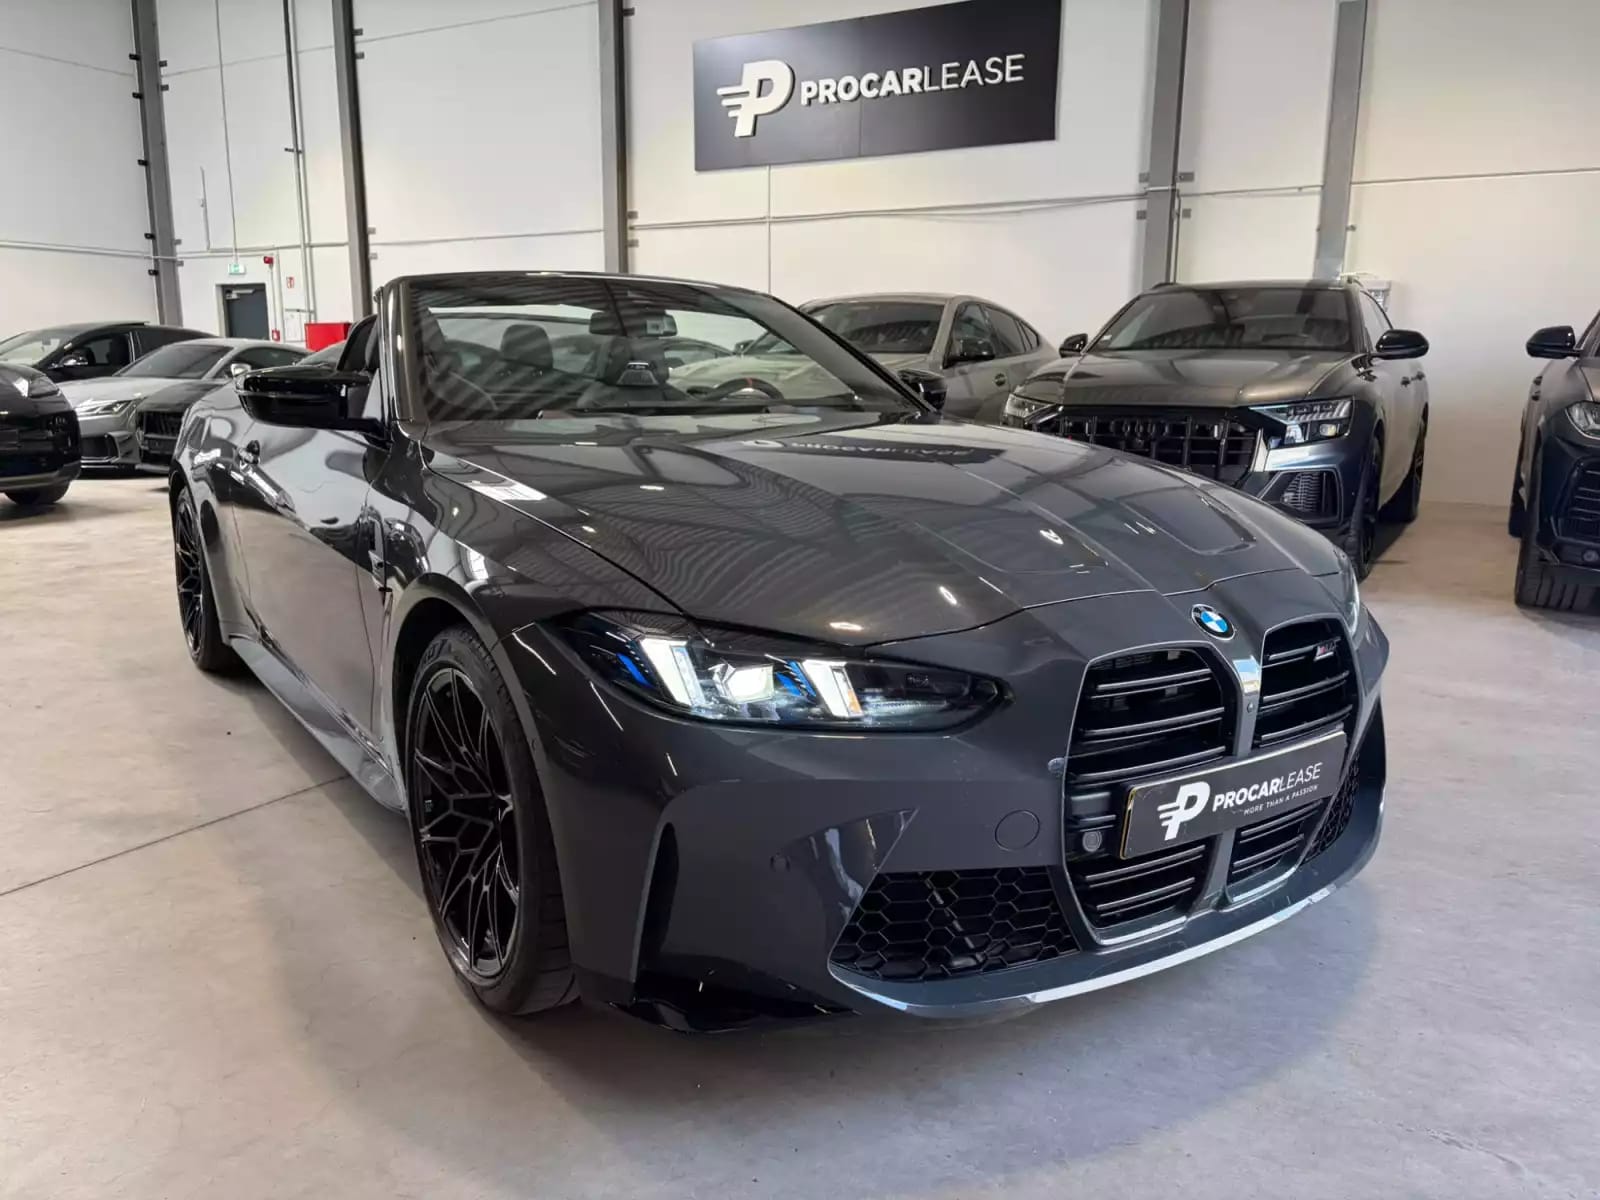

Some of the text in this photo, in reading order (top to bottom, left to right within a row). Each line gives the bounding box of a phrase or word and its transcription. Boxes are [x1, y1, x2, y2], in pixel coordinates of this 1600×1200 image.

[800, 53, 1026, 107] PROCARLEASE
[1212, 761, 1323, 813] PROCARLEASE
[1243, 803, 1265, 816] MORE
[1266, 796, 1284, 809] THAN
[1291, 783, 1319, 801] PASSION
